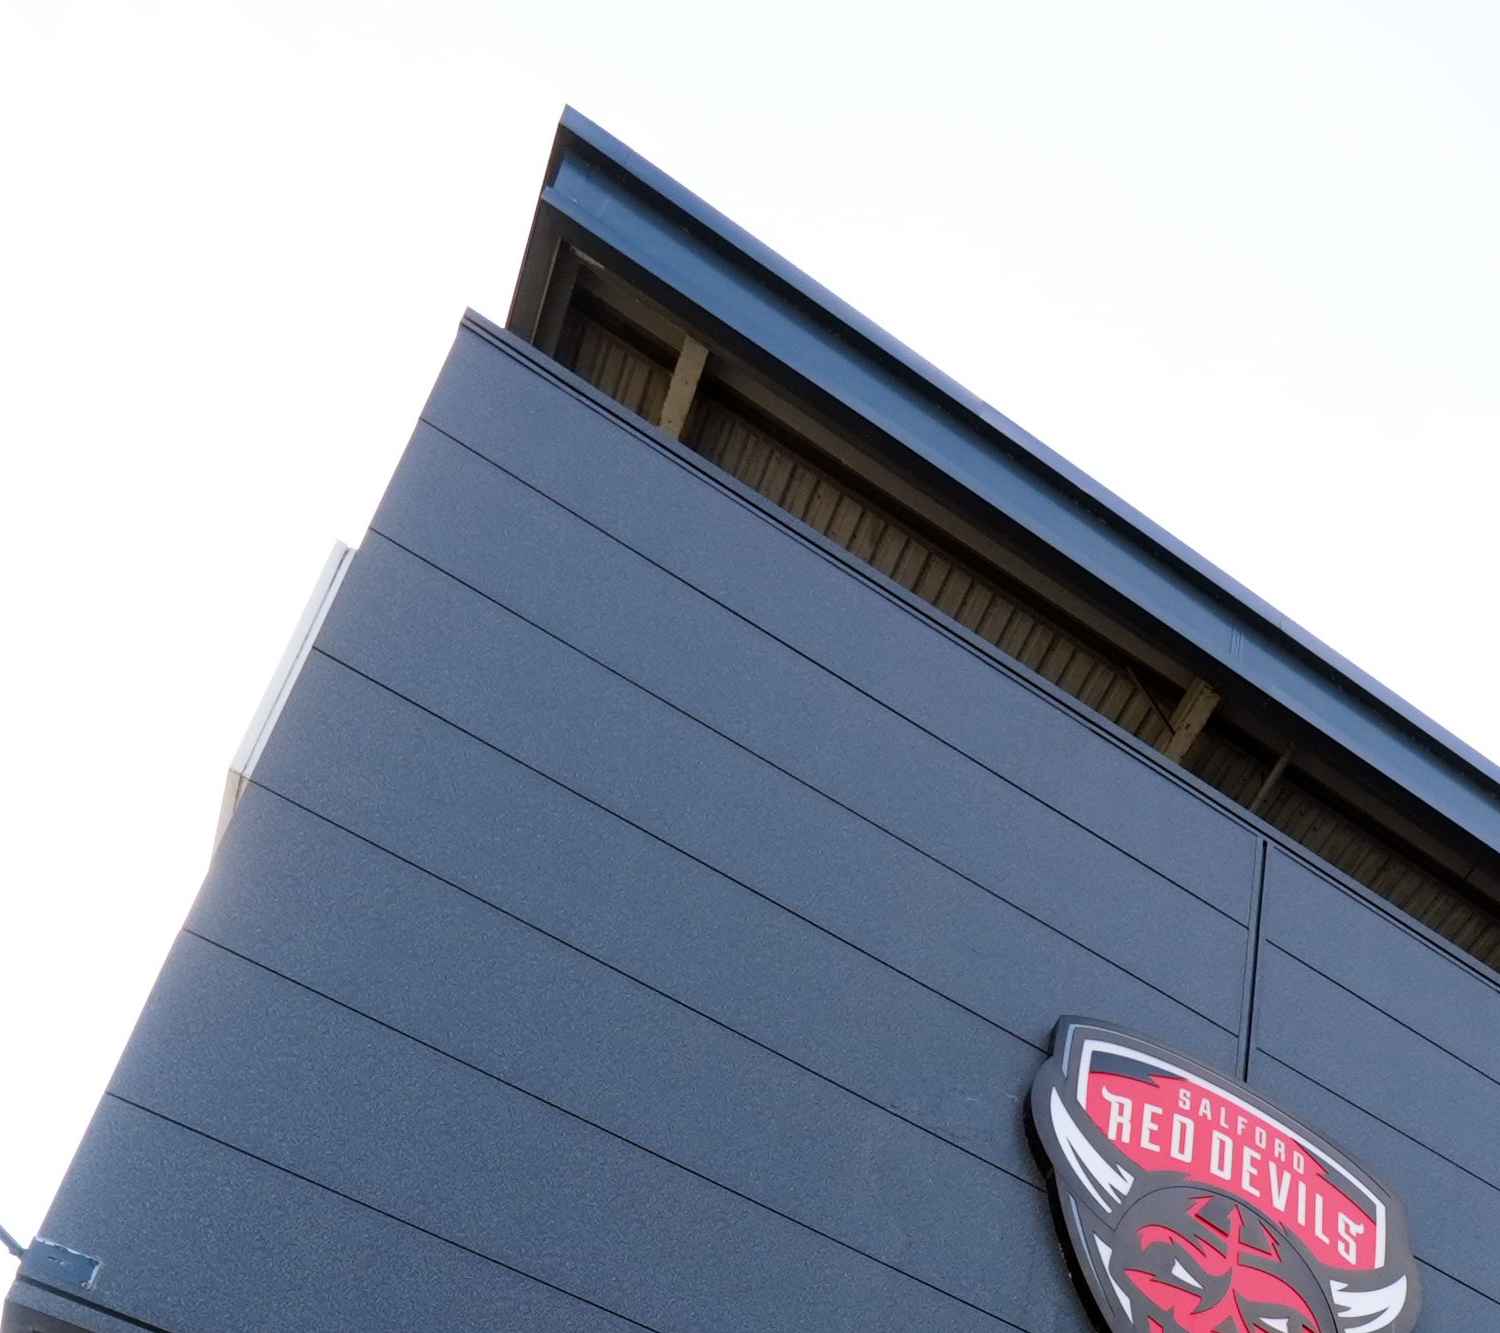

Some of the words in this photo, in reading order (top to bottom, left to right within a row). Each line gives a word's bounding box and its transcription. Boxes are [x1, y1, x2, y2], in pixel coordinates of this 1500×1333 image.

[1101, 1084, 1195, 1164] RED
[1209, 1128, 1365, 1265] DEVILS
[1178, 1087, 1305, 1175] SALFORD
